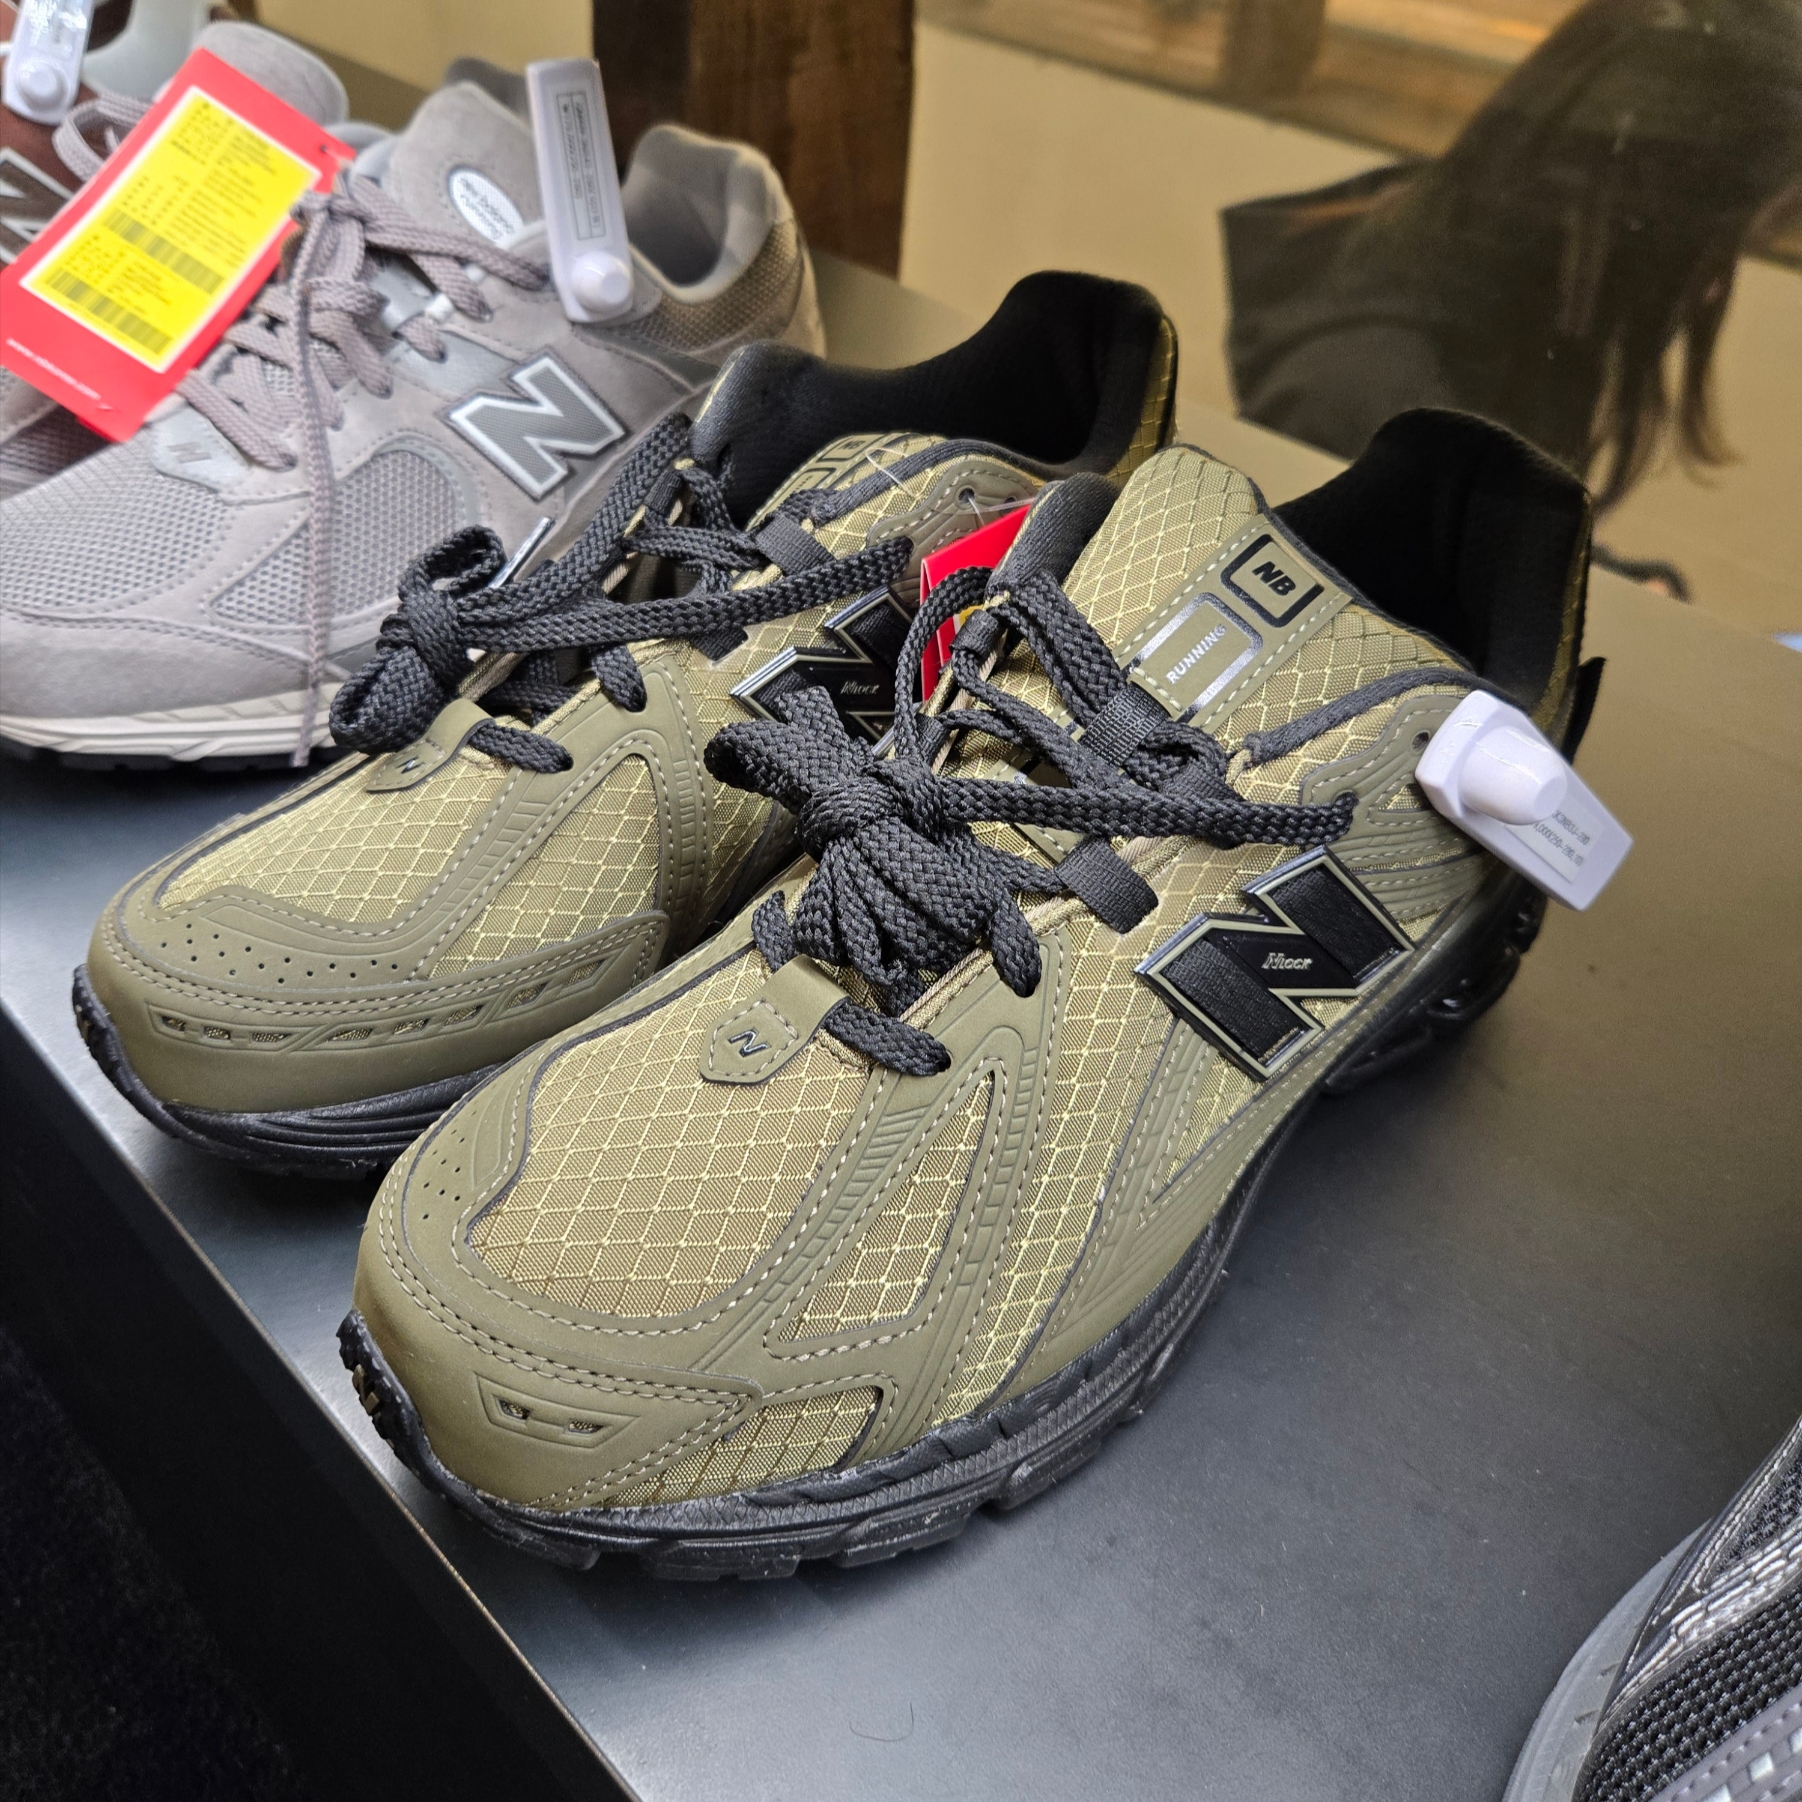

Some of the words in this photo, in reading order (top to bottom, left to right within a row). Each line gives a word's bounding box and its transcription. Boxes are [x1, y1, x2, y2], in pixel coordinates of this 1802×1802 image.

[446, 354, 626, 502] N
[1251, 561, 1296, 596] NB
[1165, 623, 1228, 685] RUNNING
[1133, 843, 1417, 1081] N
[727, 1026, 772, 1058] N
